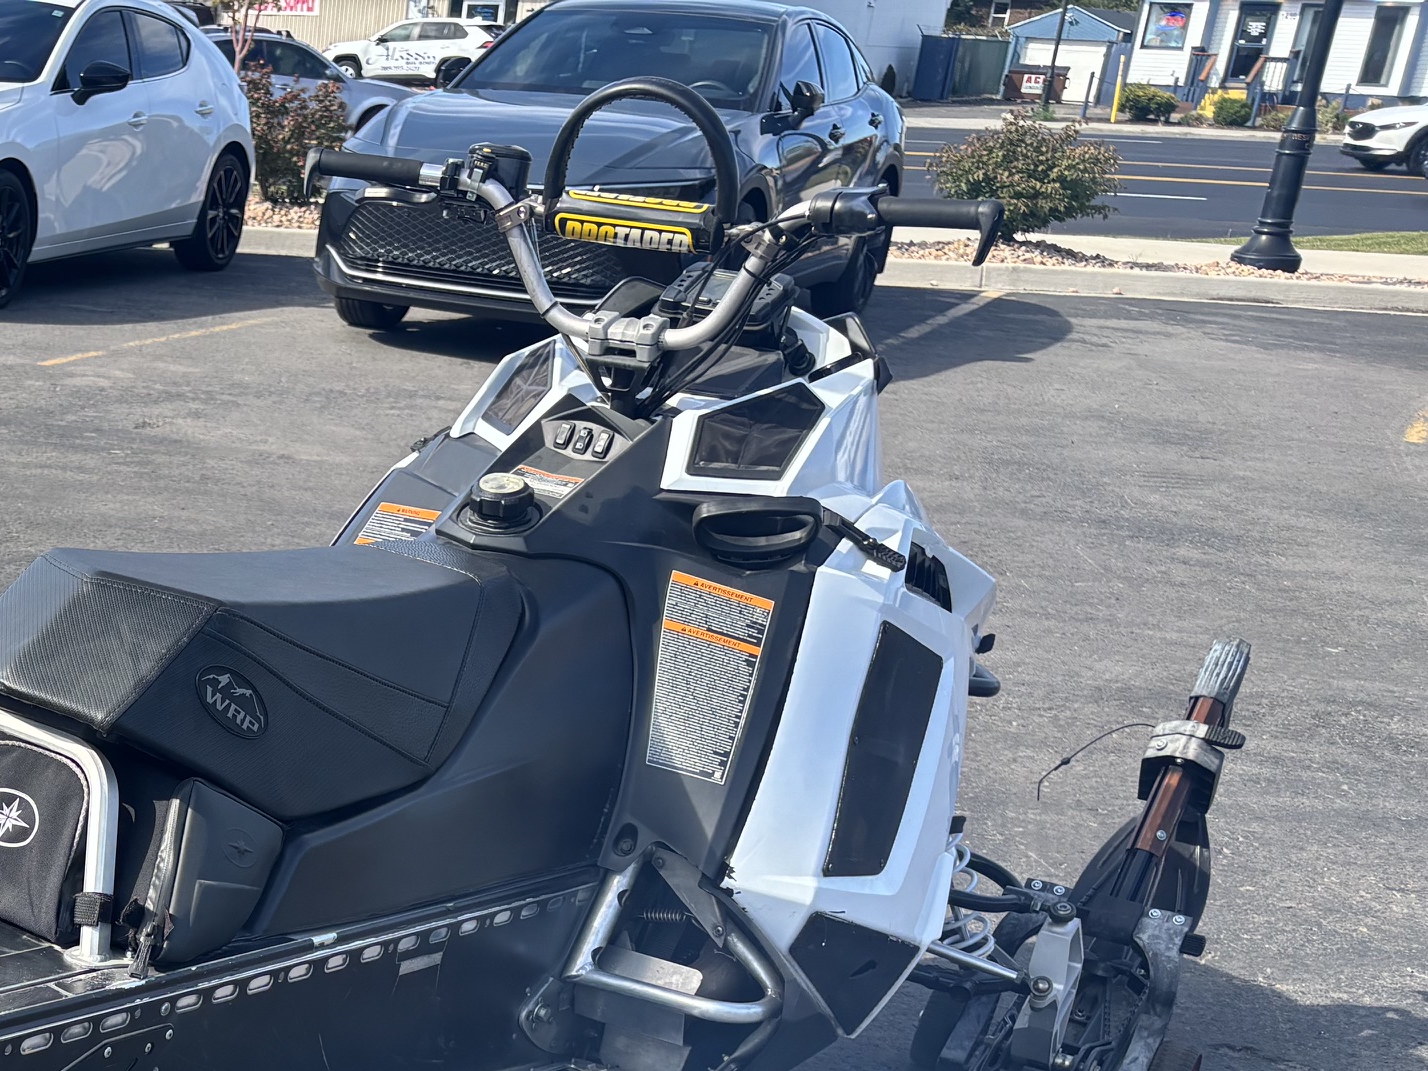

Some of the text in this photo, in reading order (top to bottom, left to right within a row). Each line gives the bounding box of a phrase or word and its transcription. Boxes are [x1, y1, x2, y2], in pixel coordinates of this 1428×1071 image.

[700, 582, 754, 603] AVERTISSEMENT
[687, 628, 742, 649] AVERTISSEMENT
[206, 684, 260, 733] WRP
